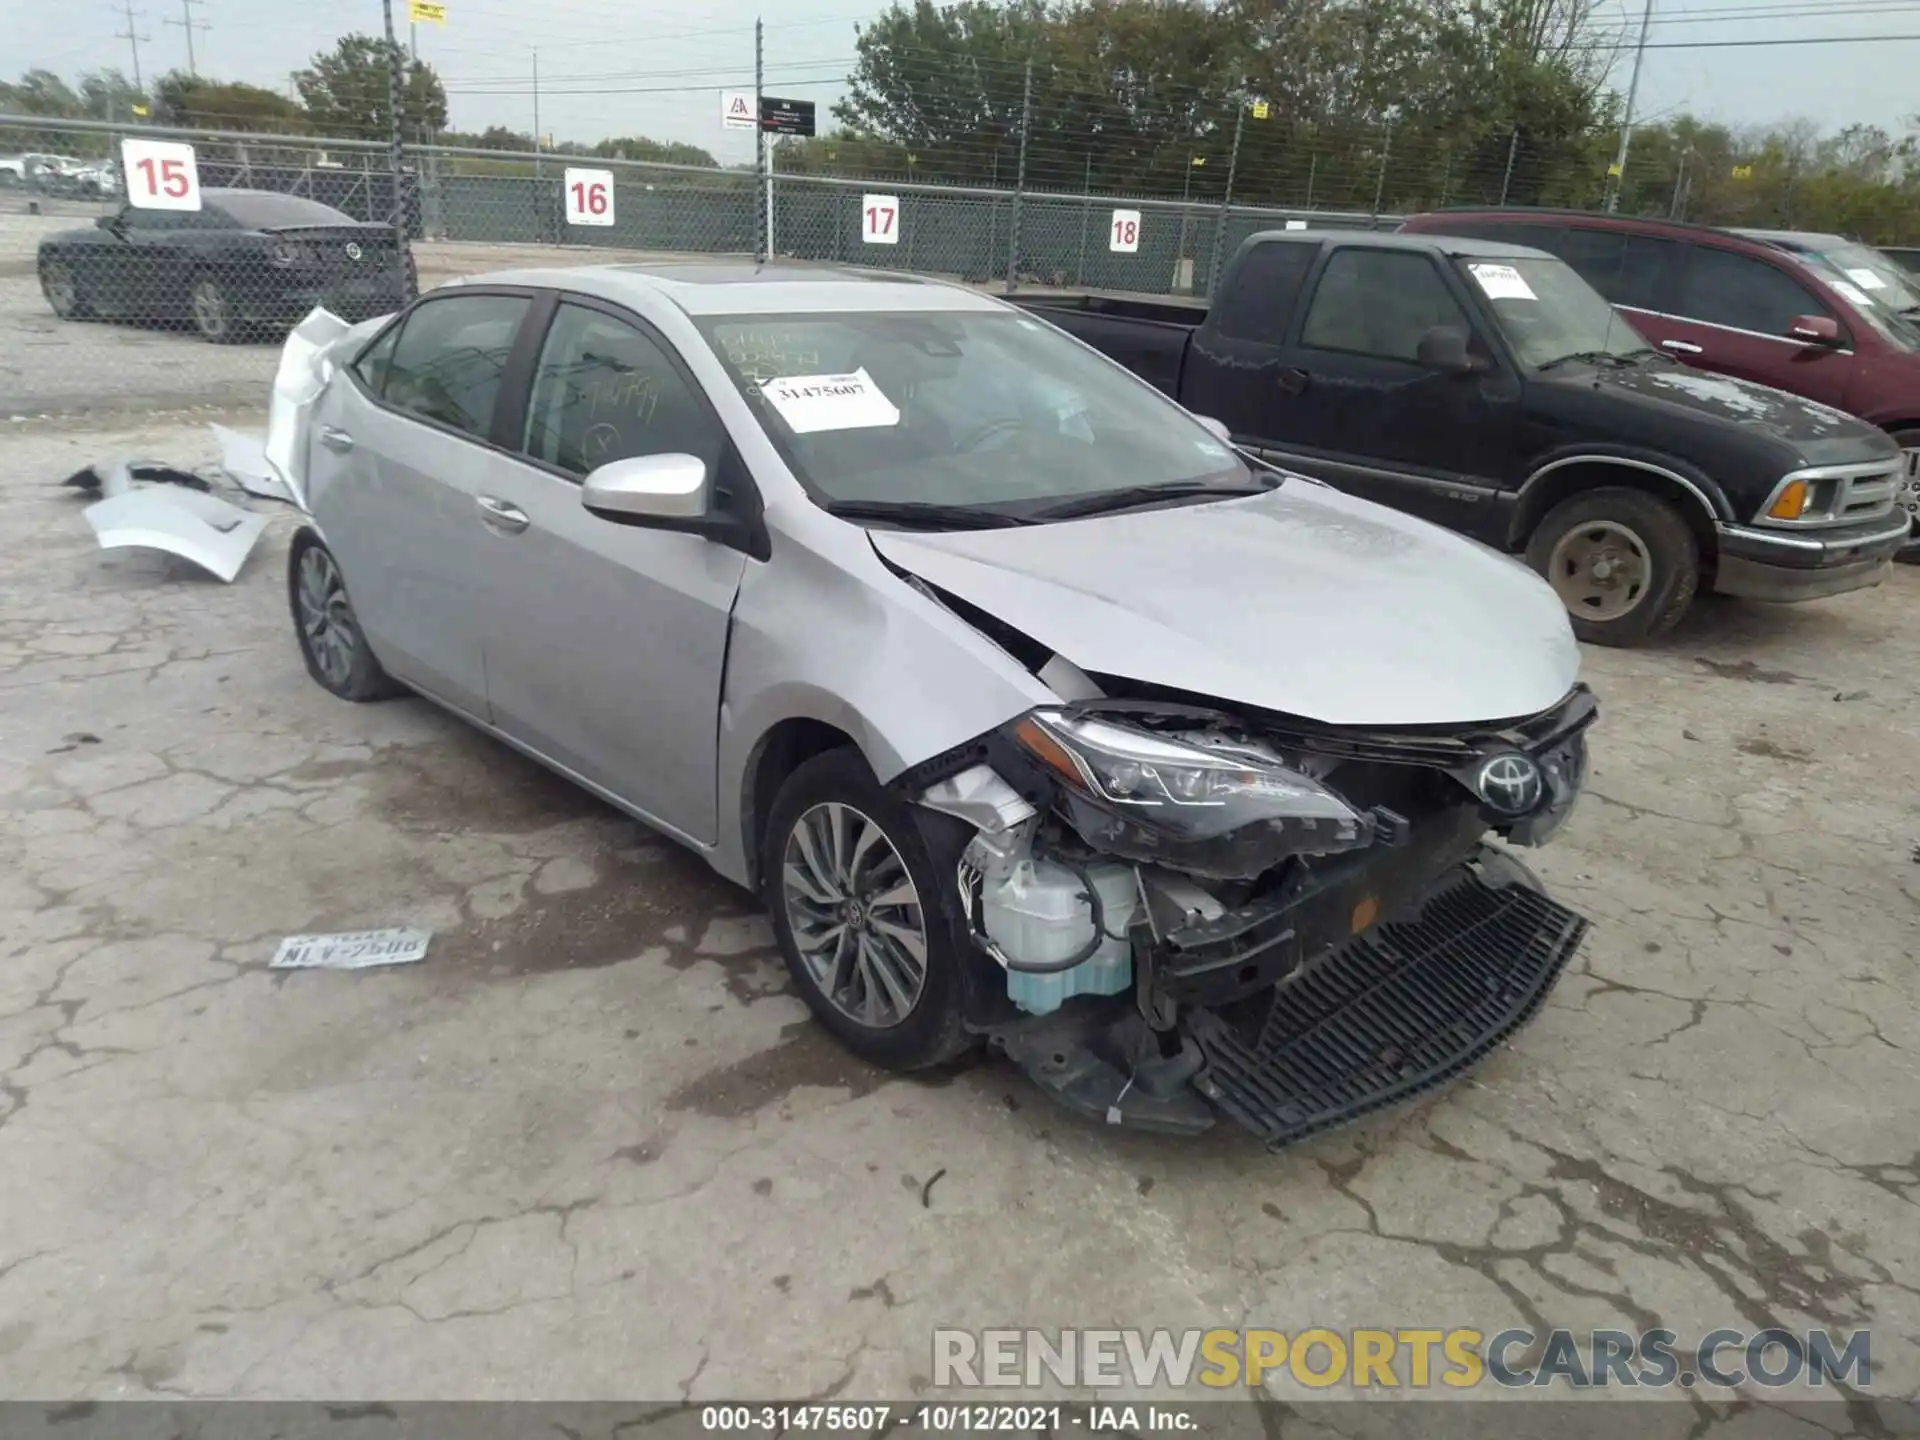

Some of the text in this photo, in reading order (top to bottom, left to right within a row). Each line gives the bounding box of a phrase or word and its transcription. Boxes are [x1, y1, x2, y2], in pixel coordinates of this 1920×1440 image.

[136, 158, 189, 198] 15
[571, 182, 607, 215] 16
[867, 207, 895, 234] 17
[1114, 220, 1136, 244] 18
[778, 384, 865, 401] 31475607
